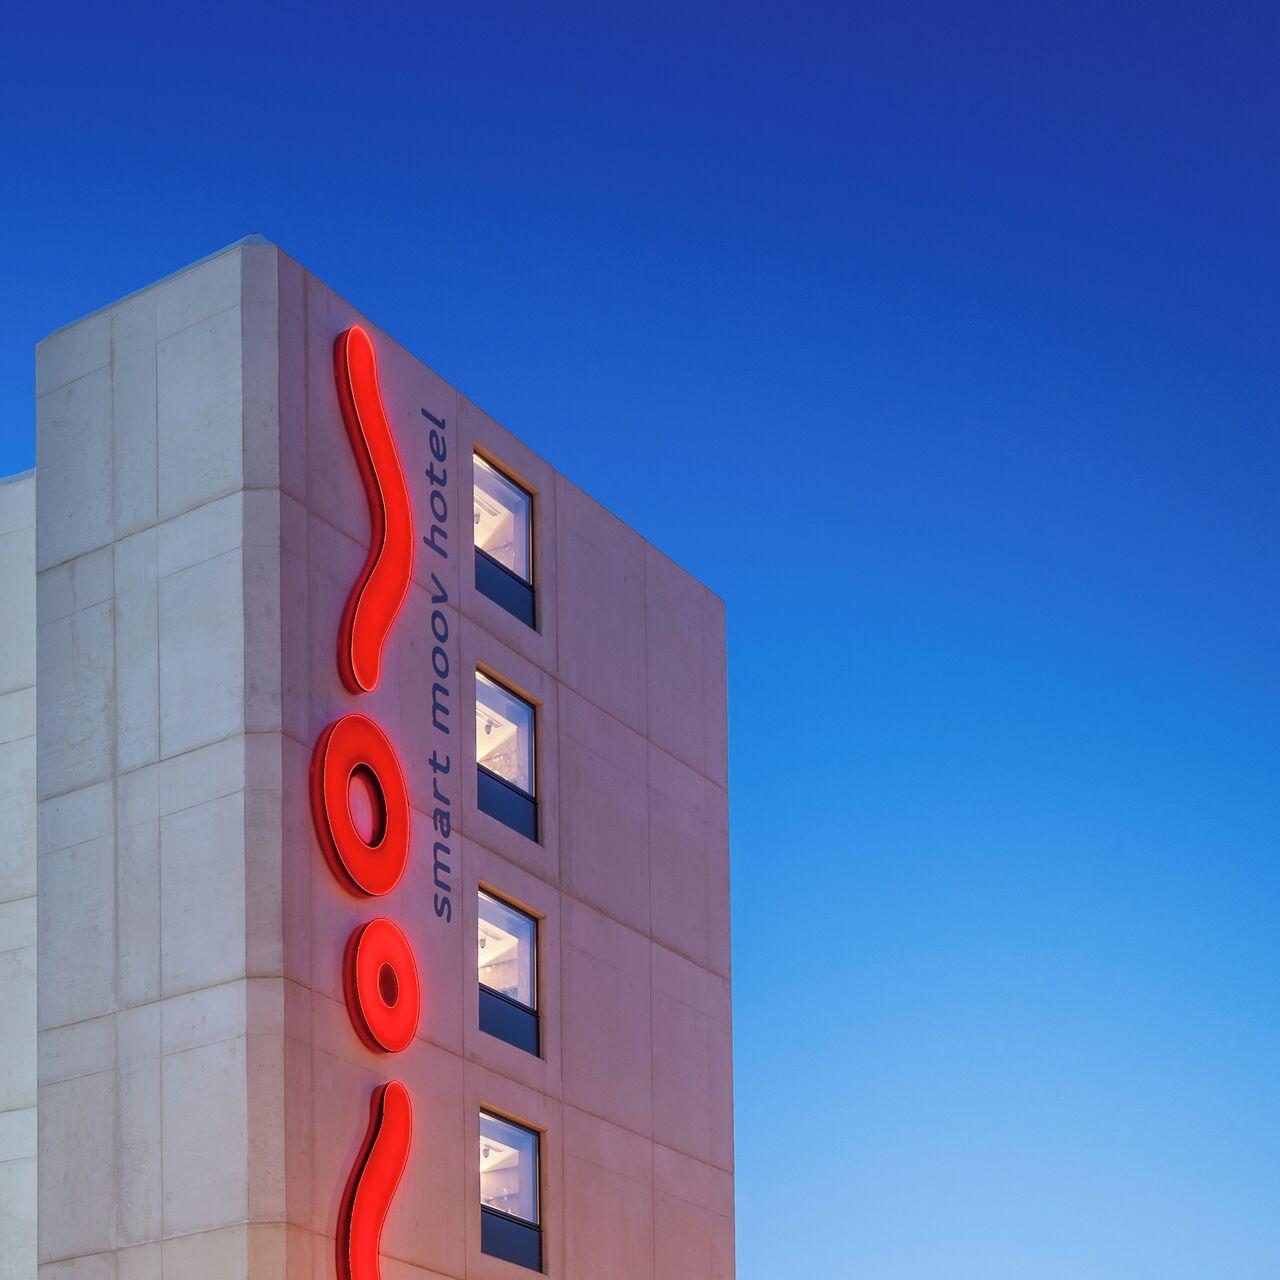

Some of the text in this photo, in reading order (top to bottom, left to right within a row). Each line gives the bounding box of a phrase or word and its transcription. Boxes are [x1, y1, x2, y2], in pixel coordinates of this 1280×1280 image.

[421, 407, 452, 923] smart moov hotel
